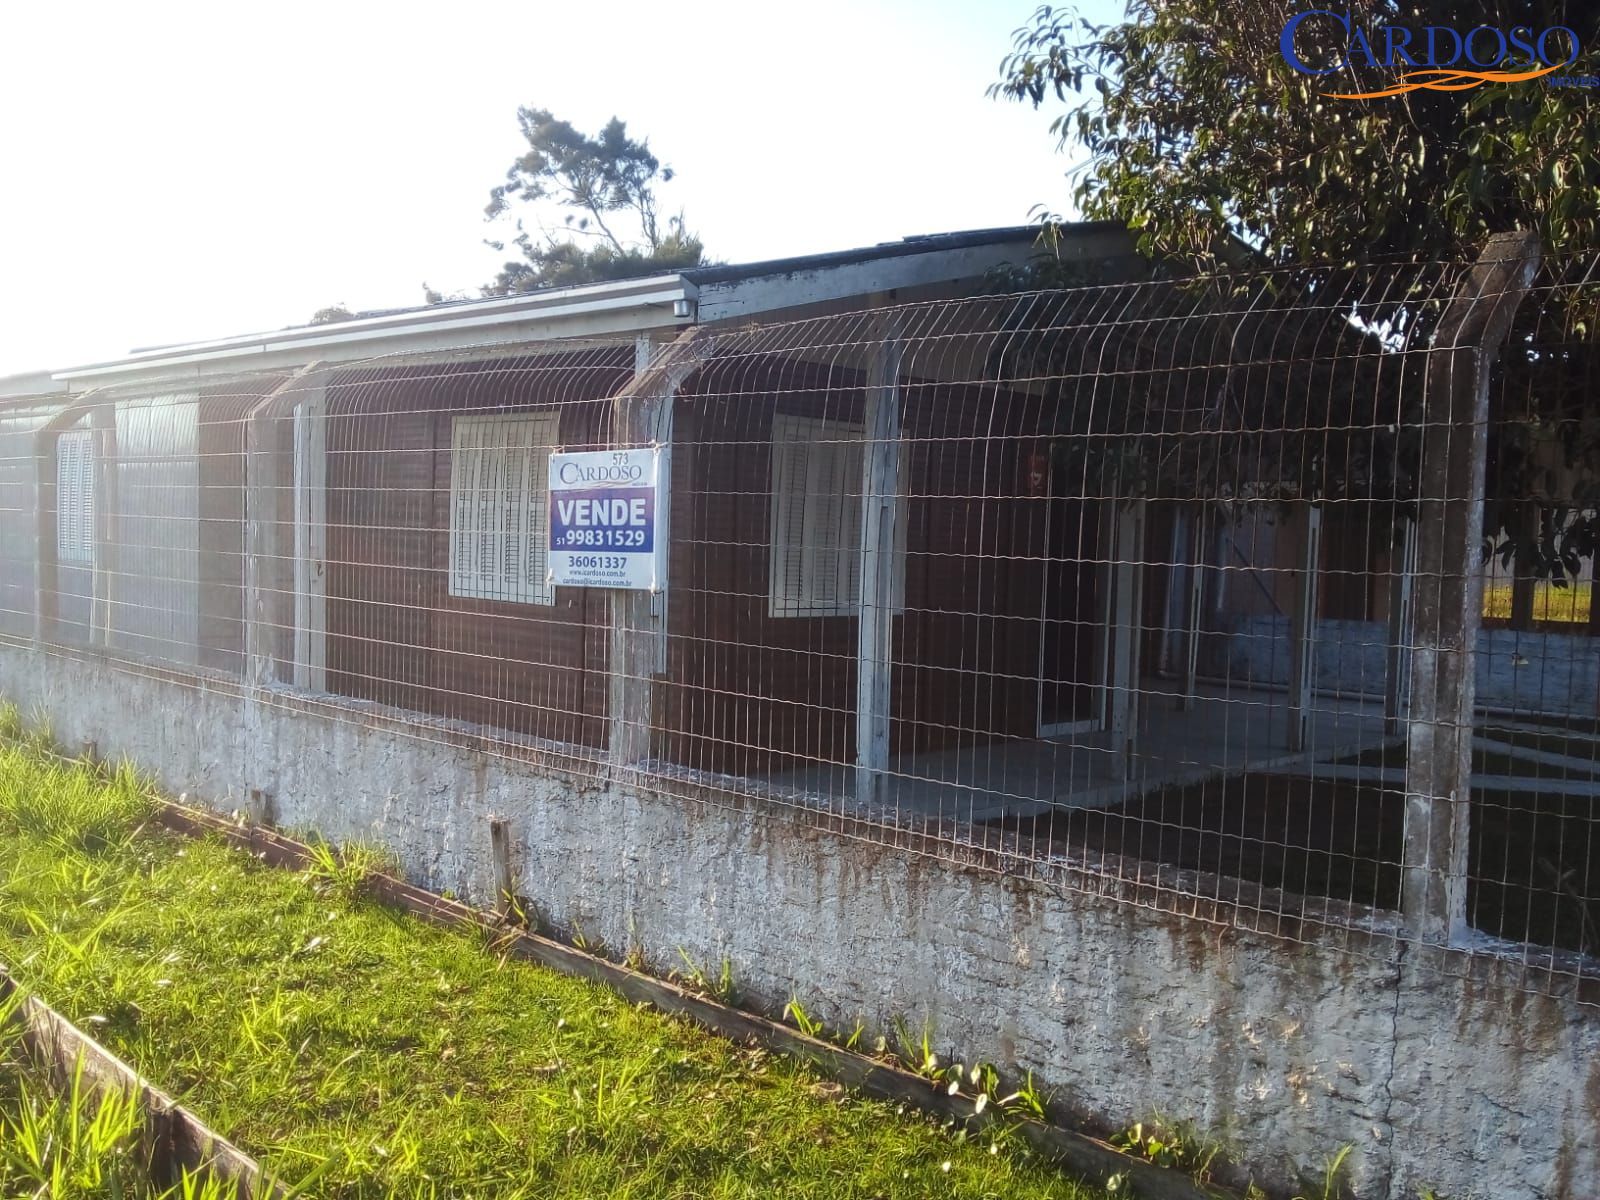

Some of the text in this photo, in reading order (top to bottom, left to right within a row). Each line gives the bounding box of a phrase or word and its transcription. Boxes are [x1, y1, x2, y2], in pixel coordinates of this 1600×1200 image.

[612, 453, 629, 466] 573
[560, 462, 642, 484] CARDOSO
[557, 498, 647, 527] VENDE
[556, 530, 645, 546] 51 99831529
[568, 556, 627, 569] 36061337
